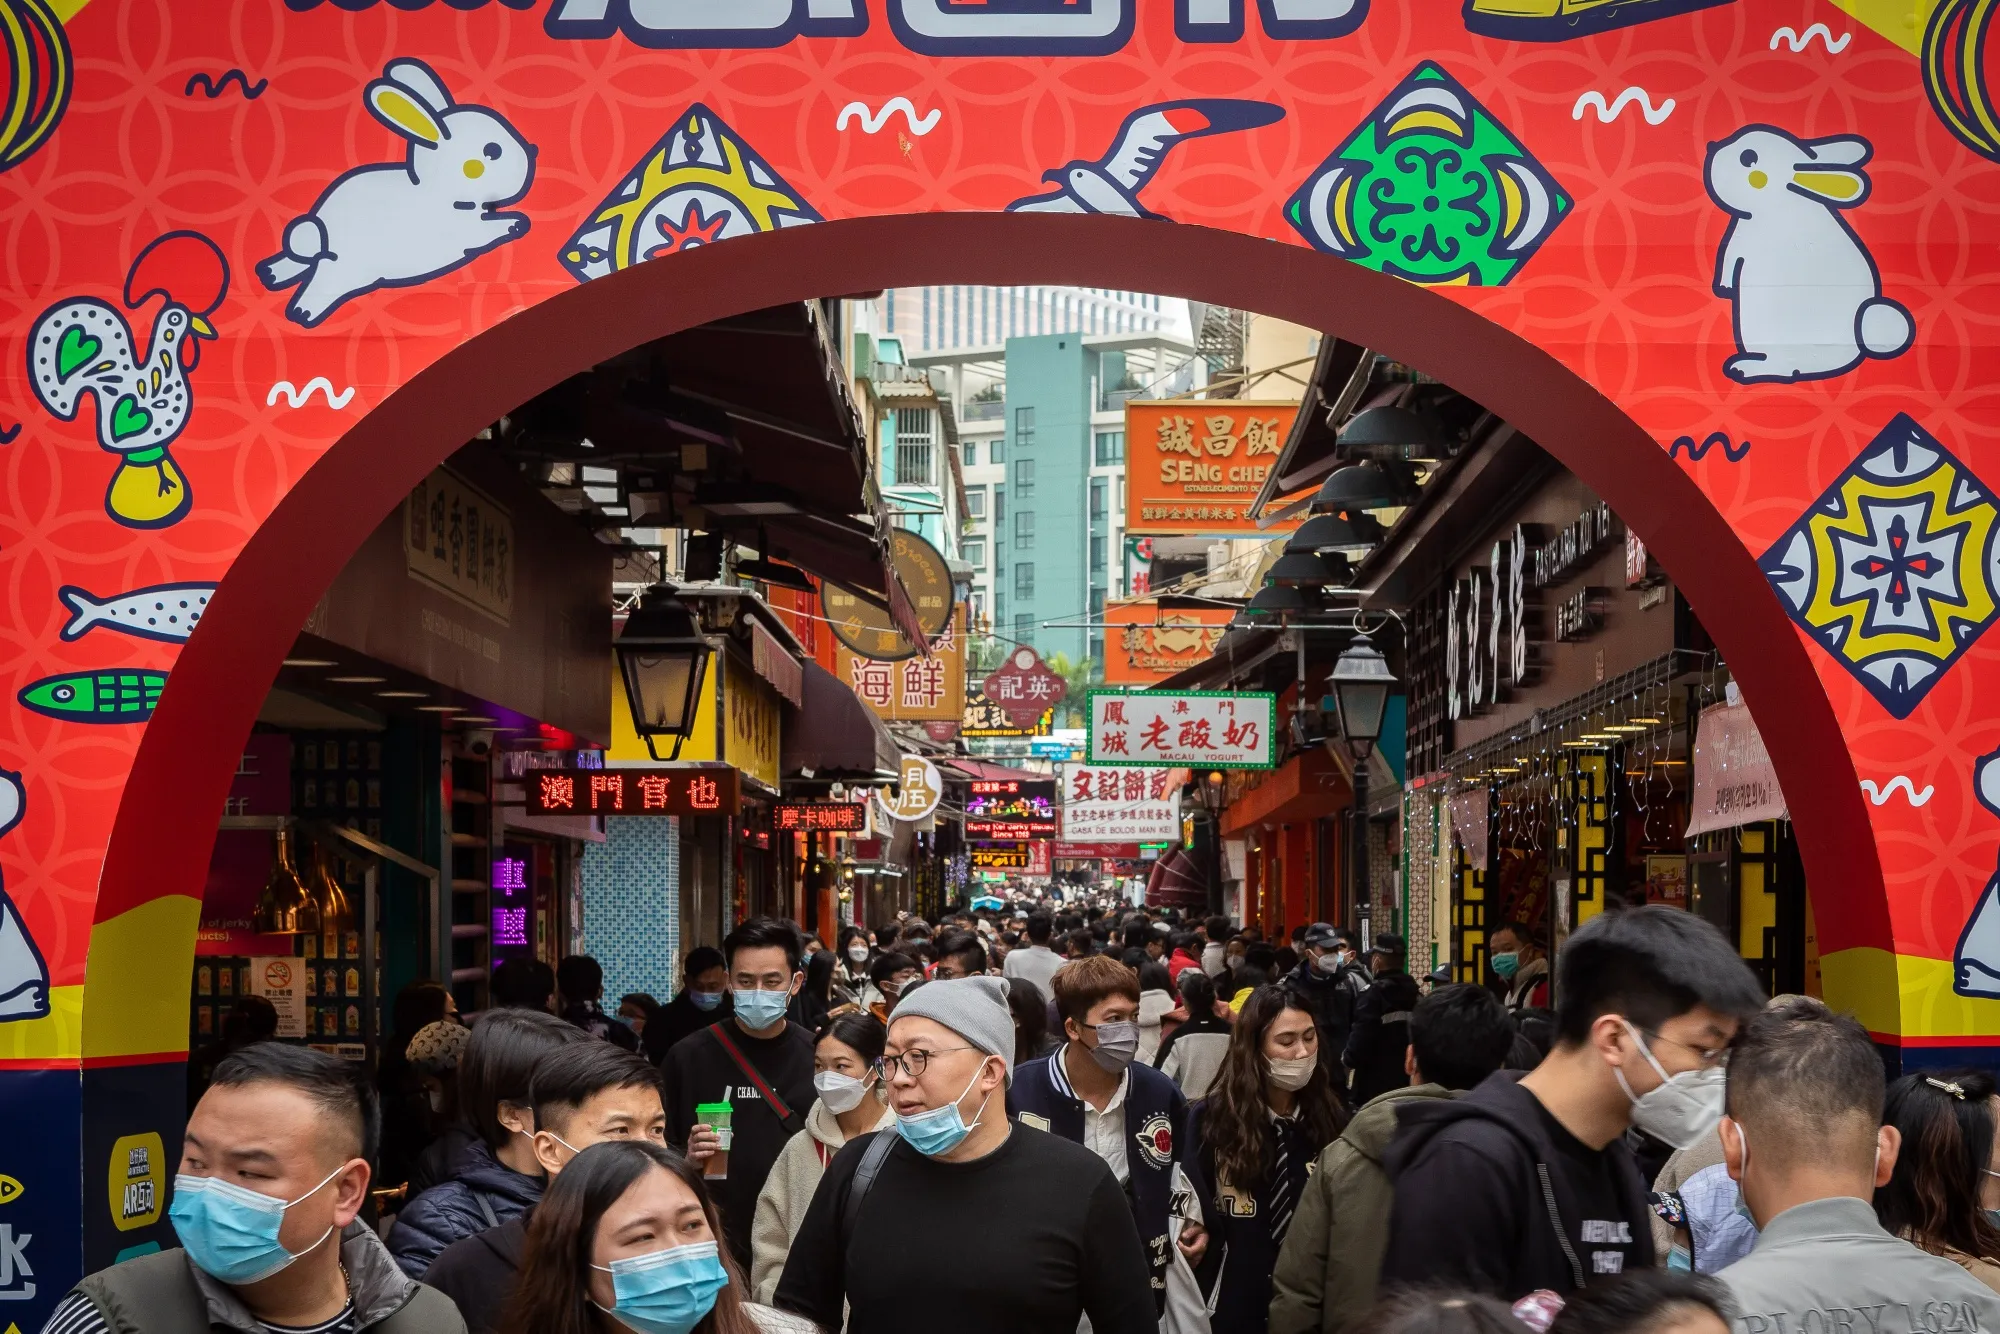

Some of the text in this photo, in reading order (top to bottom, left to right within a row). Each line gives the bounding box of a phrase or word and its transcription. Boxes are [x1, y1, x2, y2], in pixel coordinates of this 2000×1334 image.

[1161, 459, 1222, 483] SENG
[1535, 518, 1577, 588] PASTELARIA
[853, 659, 945, 708] 海鮮
[1171, 700, 1235, 716] 澳門
[1102, 702, 1130, 756] 鳳城
[1140, 715, 1260, 751] 老酸奶
[1160, 753, 1244, 762] MACAU YOGURT
[541, 775, 720, 809] 澳門官也
[781, 808, 856, 827] 摩卡咖啡
